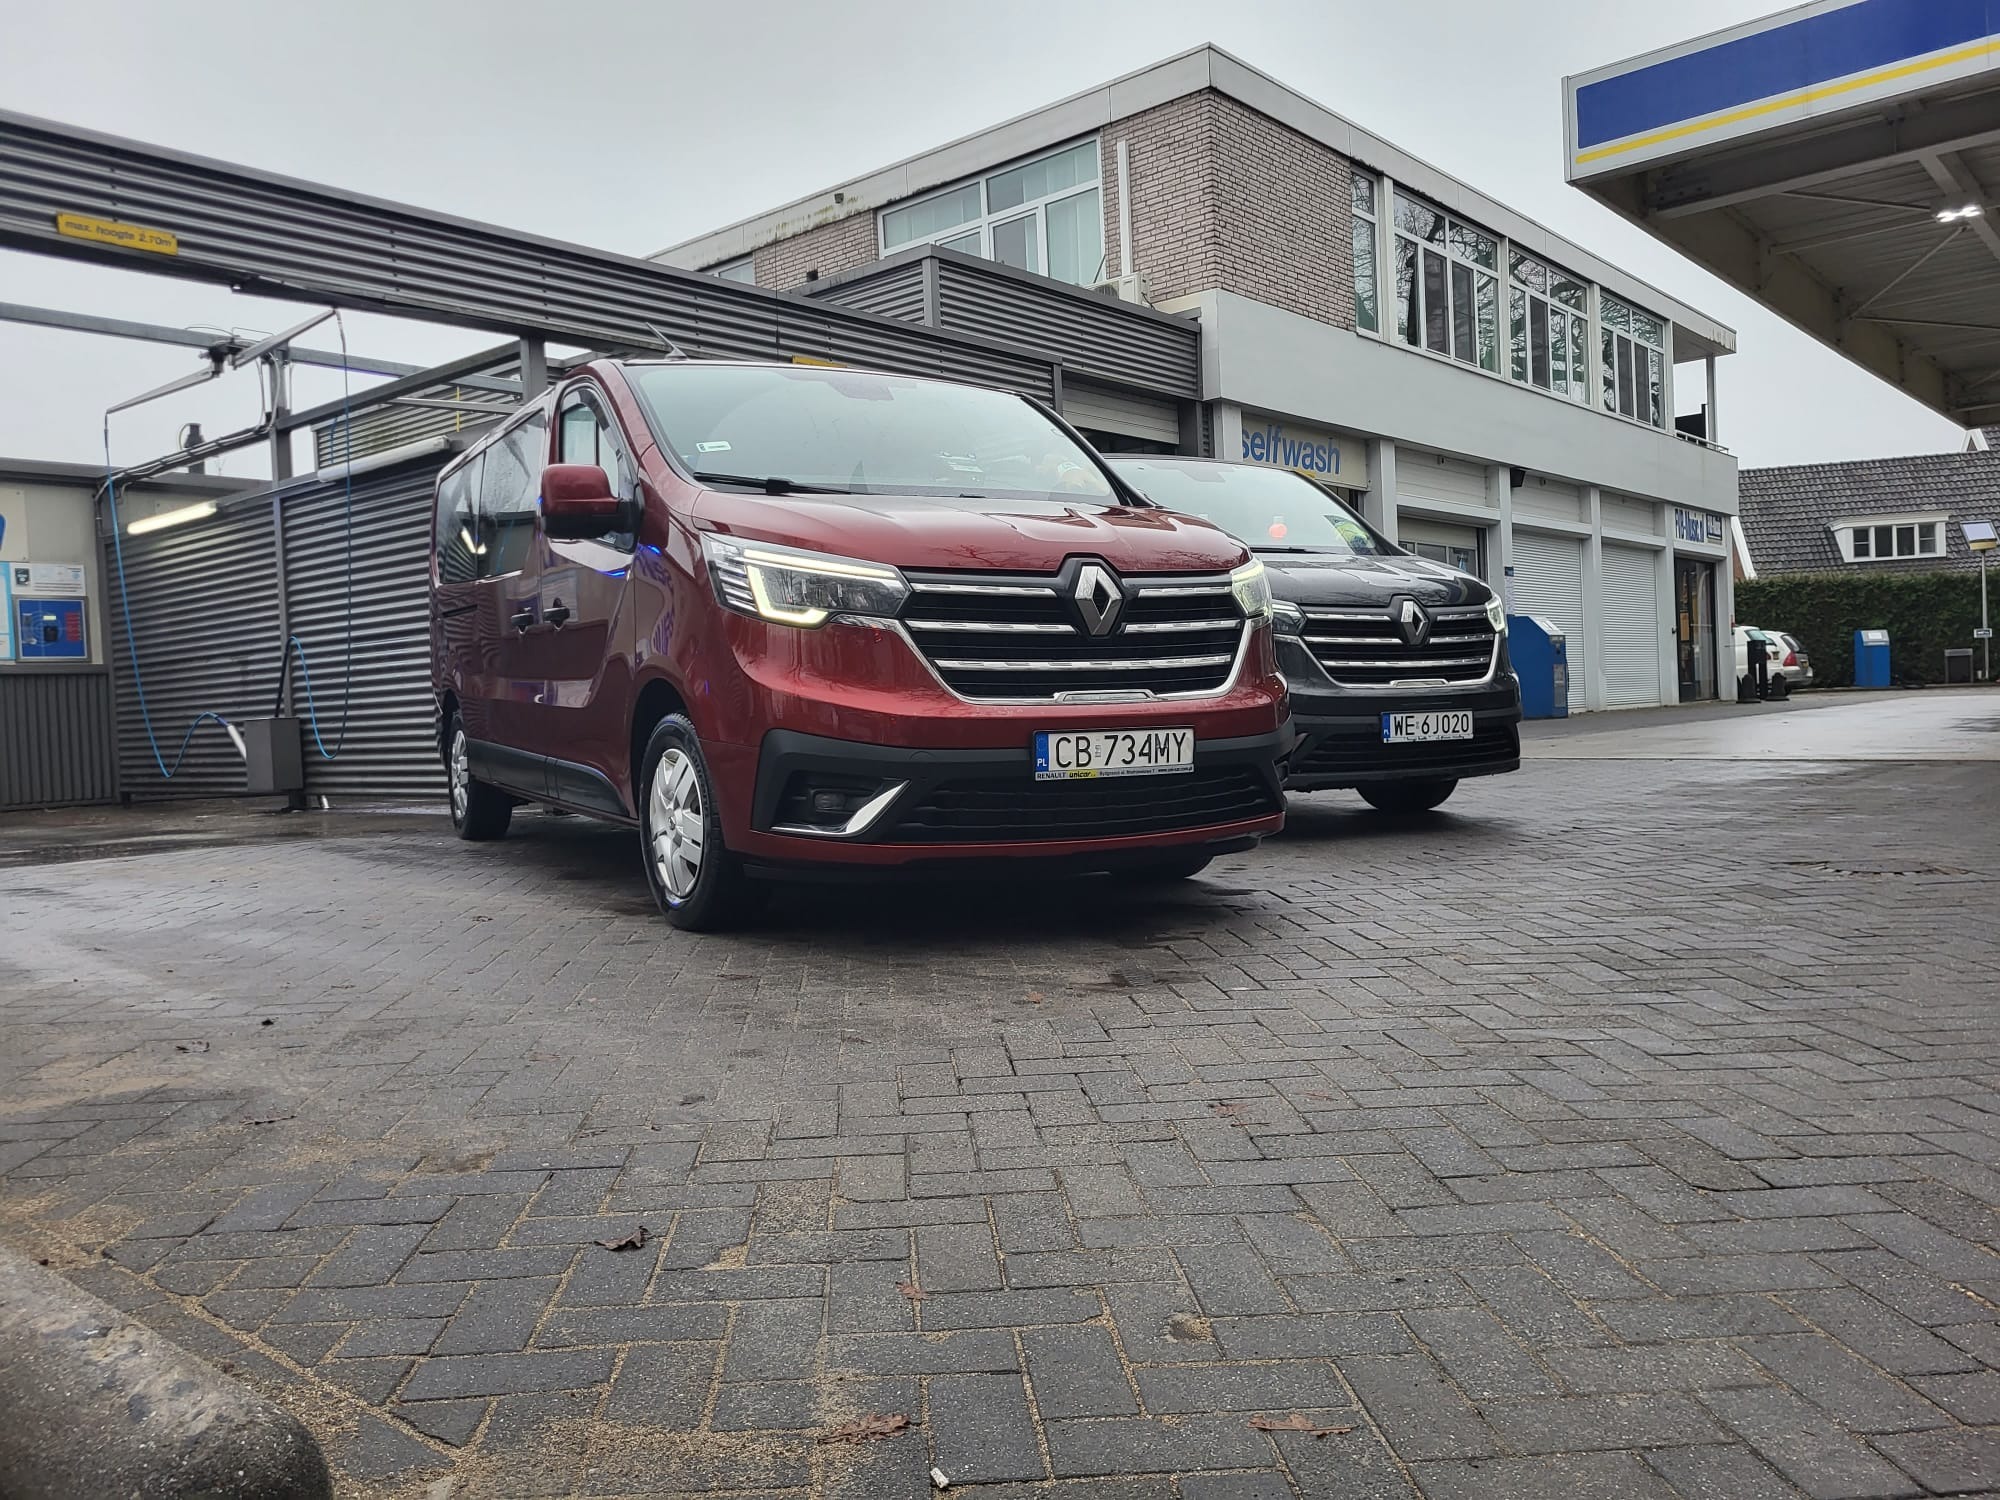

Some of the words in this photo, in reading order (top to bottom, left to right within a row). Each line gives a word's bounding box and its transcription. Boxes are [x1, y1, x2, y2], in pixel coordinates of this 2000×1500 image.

[96, 225, 135, 241] hoogte
[1242, 424, 1341, 474] selfwash
[1394, 715, 1415, 736] WE
[1421, 714, 1469, 735] 6J020
[1055, 735, 1092, 768] CB
[1104, 732, 1186, 766] 734MY
[1037, 758, 1047, 767] PL
[1036, 771, 1067, 779] RENAULT
